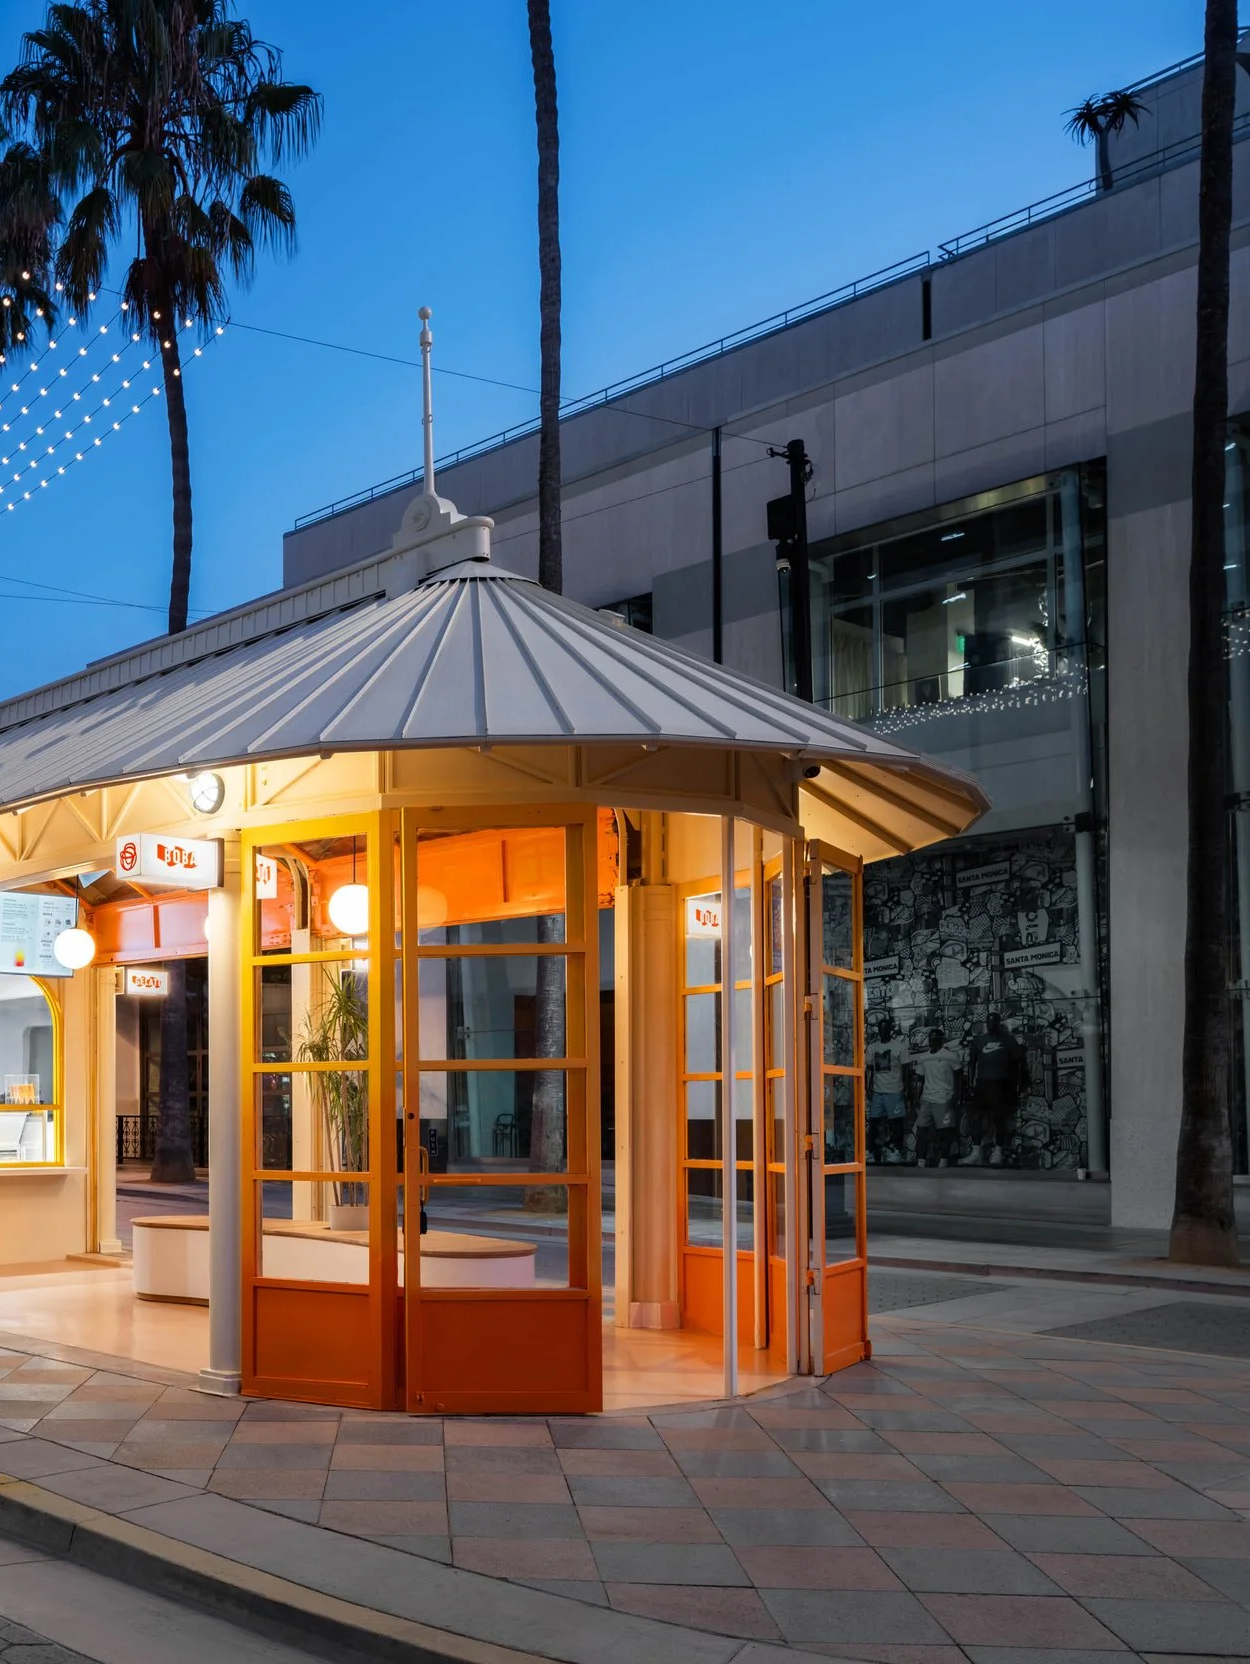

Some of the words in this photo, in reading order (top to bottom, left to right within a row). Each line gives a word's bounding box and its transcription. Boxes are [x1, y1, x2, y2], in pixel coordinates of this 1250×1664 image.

[157, 844, 198, 869] BOBA
[957, 873, 980, 883] SANTA
[981, 868, 1008, 879] MONICA
[1006, 955, 1029, 965] SANTA
[1030, 950, 1059, 962] MONICA
[873, 963, 897, 973] MONICA
[1058, 1055, 1083, 1065] SANTA
